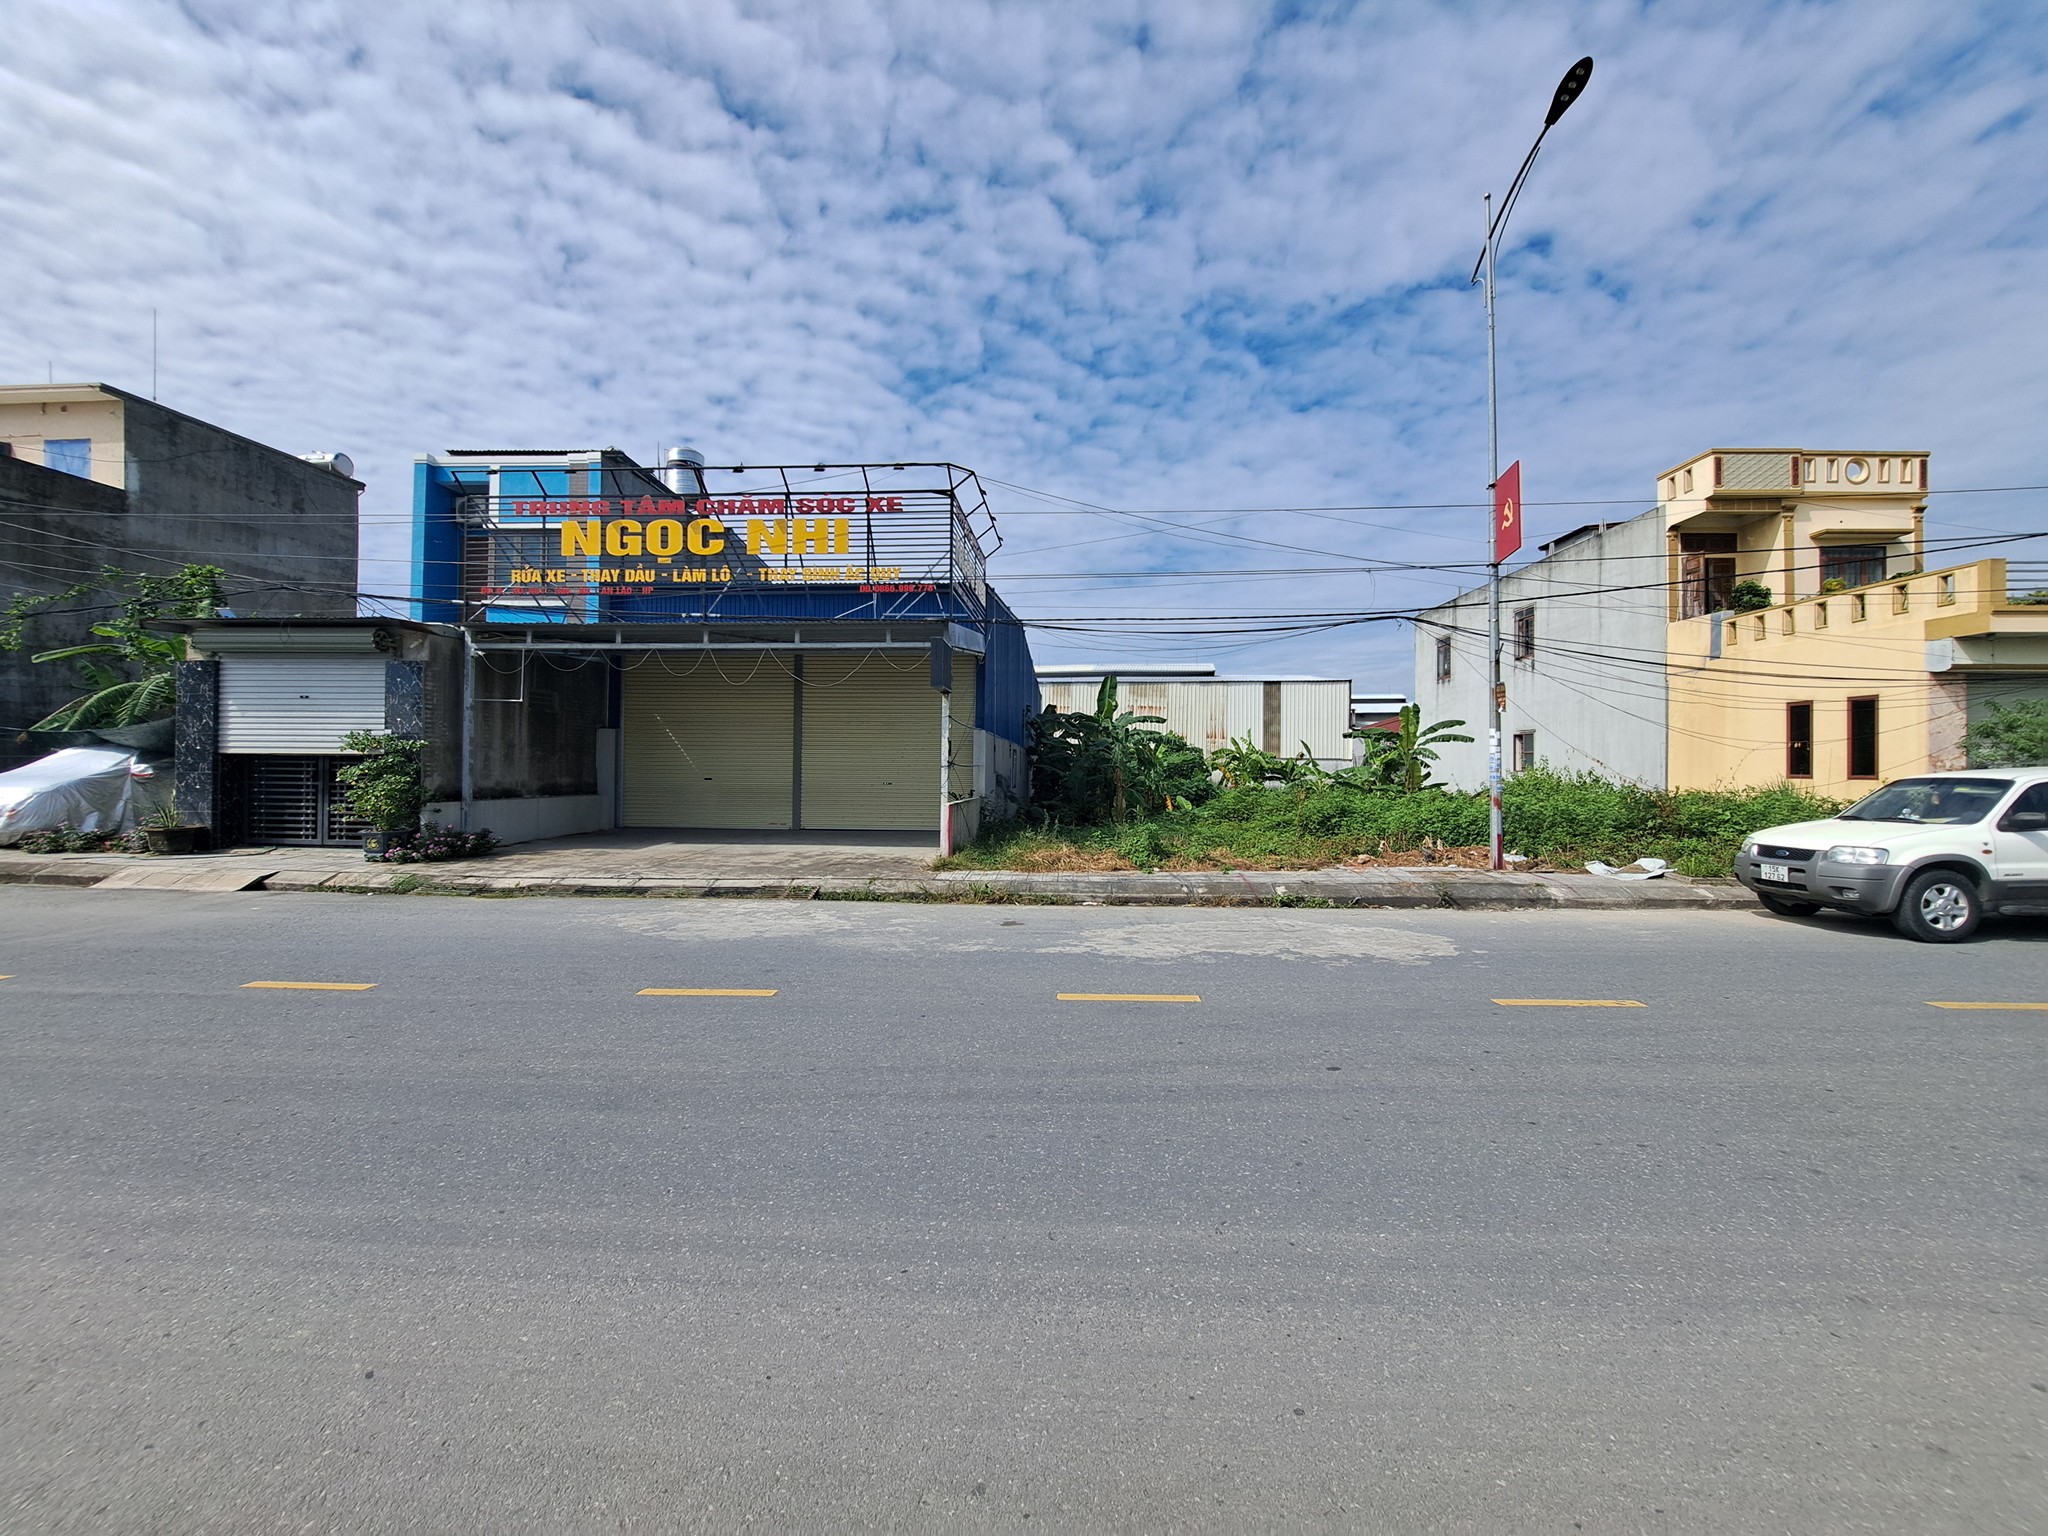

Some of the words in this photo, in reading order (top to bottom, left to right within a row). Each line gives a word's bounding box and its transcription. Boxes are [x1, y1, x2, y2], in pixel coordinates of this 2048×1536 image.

[511, 500, 610, 515] TRUNG
[620, 495, 686, 515] TÂM
[696, 494, 785, 515] CHĂM
[795, 492, 855, 514] SÓC
[865, 497, 904, 513] XE
[560, 518, 725, 564] NGỌC
[746, 518, 849, 555] NHI
[545, 569, 566, 583] XE
[581, 569, 620, 583] THAY
[625, 562, 656, 583] DẦU
[672, 565, 707, 583] LÀM
[758, 567, 797, 582] THAY
